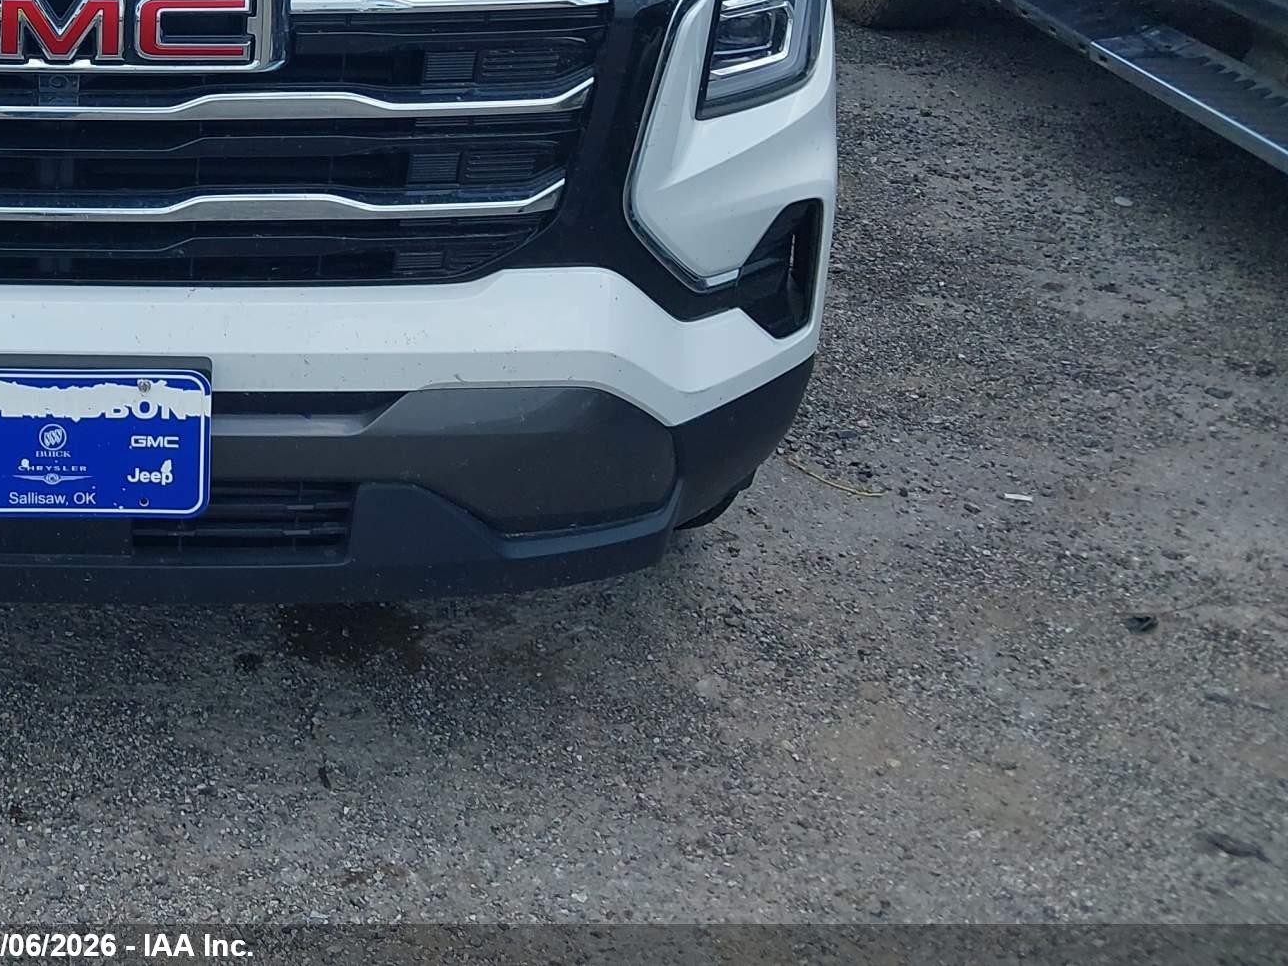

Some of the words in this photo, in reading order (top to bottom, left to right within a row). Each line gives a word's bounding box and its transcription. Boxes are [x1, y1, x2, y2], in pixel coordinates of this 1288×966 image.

[131, 435, 179, 448] GMC
[35, 450, 72, 458] BUICK
[17, 464, 88, 472] CHRYSLER
[127, 467, 173, 485] Jeep
[8, 491, 69, 506] Sallisaw,
[73, 491, 97, 505] OK
